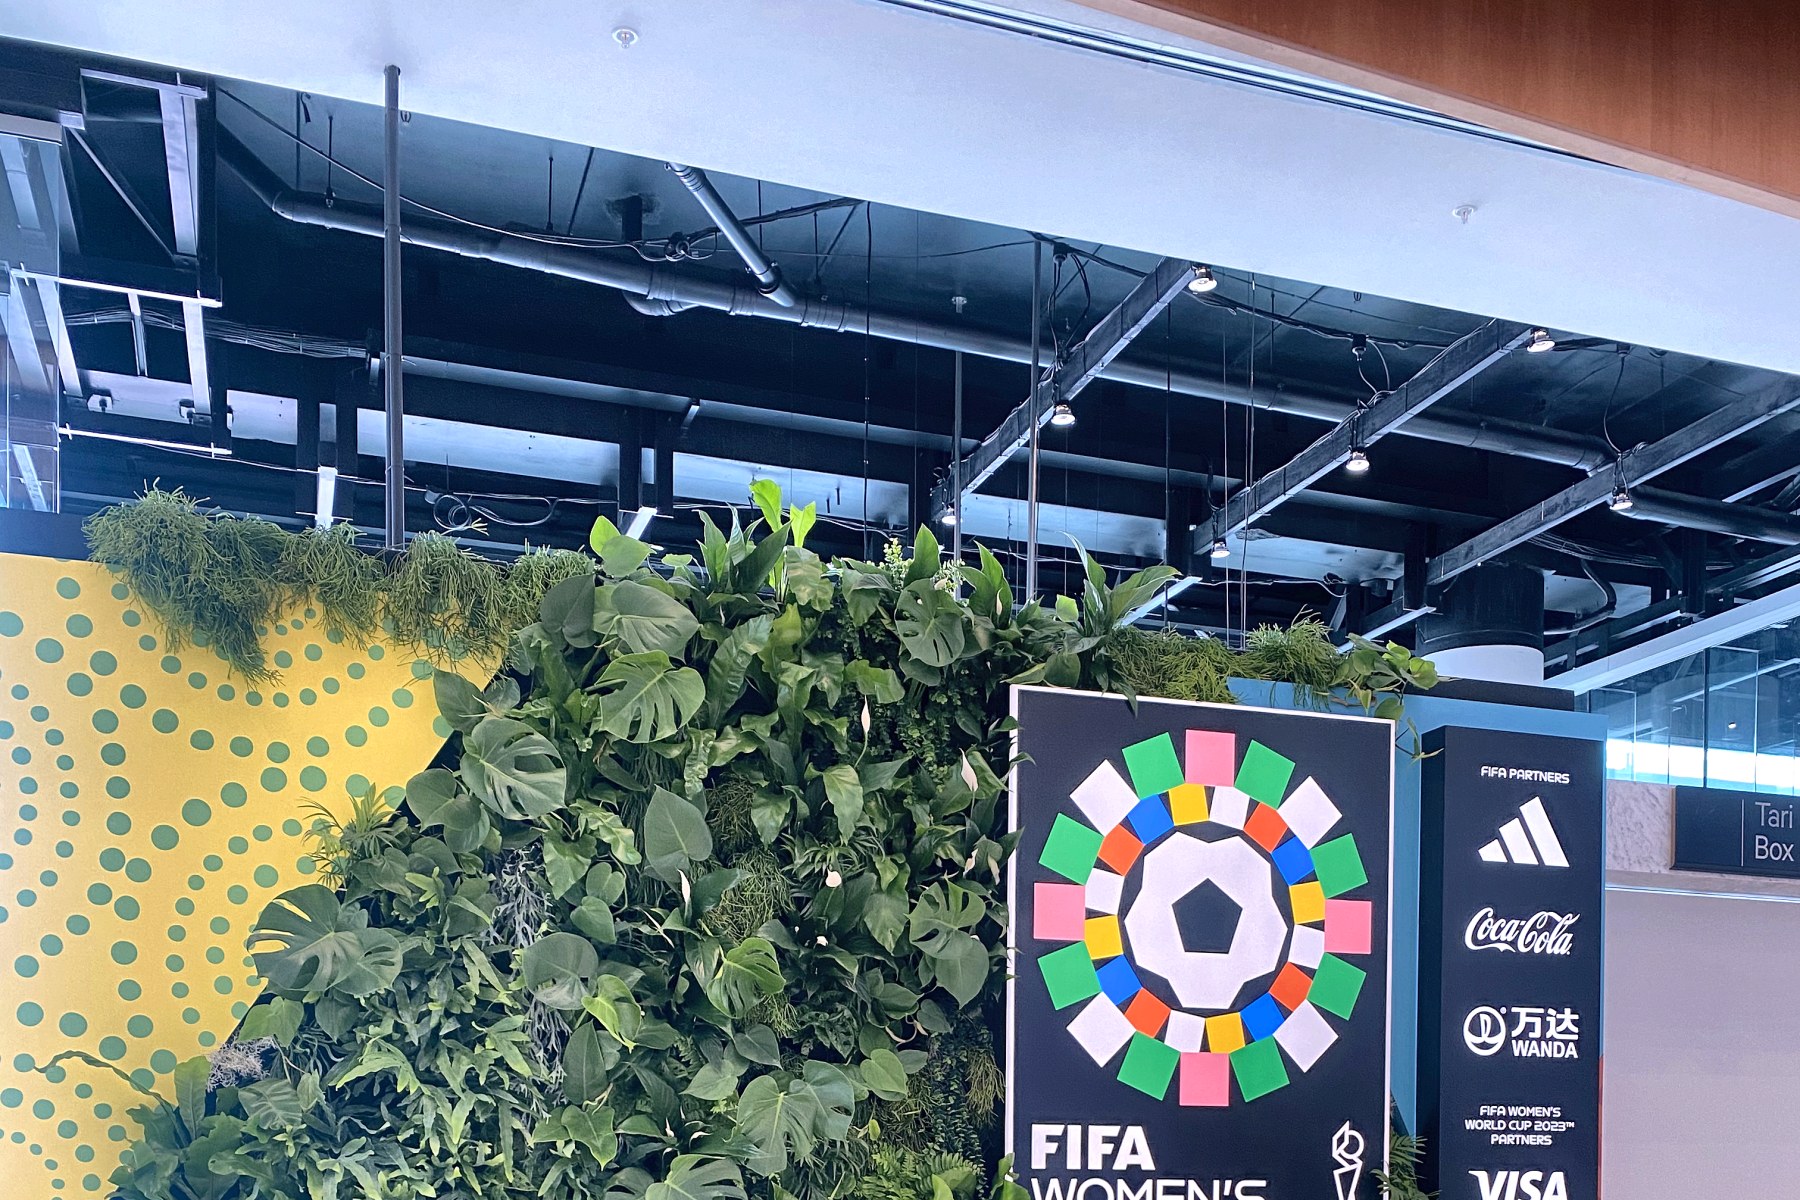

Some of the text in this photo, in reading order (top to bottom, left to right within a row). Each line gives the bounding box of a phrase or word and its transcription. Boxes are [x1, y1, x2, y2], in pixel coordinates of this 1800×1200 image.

[1480, 765, 1570, 784] FIFA PARTNERS
[1755, 801, 1793, 829] Tari
[1755, 834, 1794, 862] Box
[1464, 907, 1581, 956] Coca-Cola
[1510, 1006, 1580, 1040] 万达
[1511, 1039, 1579, 1059] WANDA
[1479, 1105, 1562, 1118] FIFA WOMEN'S
[1464, 1119, 1507, 1131] WORLD
[1508, 1120, 1533, 1131] CUP
[1030, 1123, 1156, 1171] FIFA
[1490, 1134, 1553, 1146] PARTNERS
